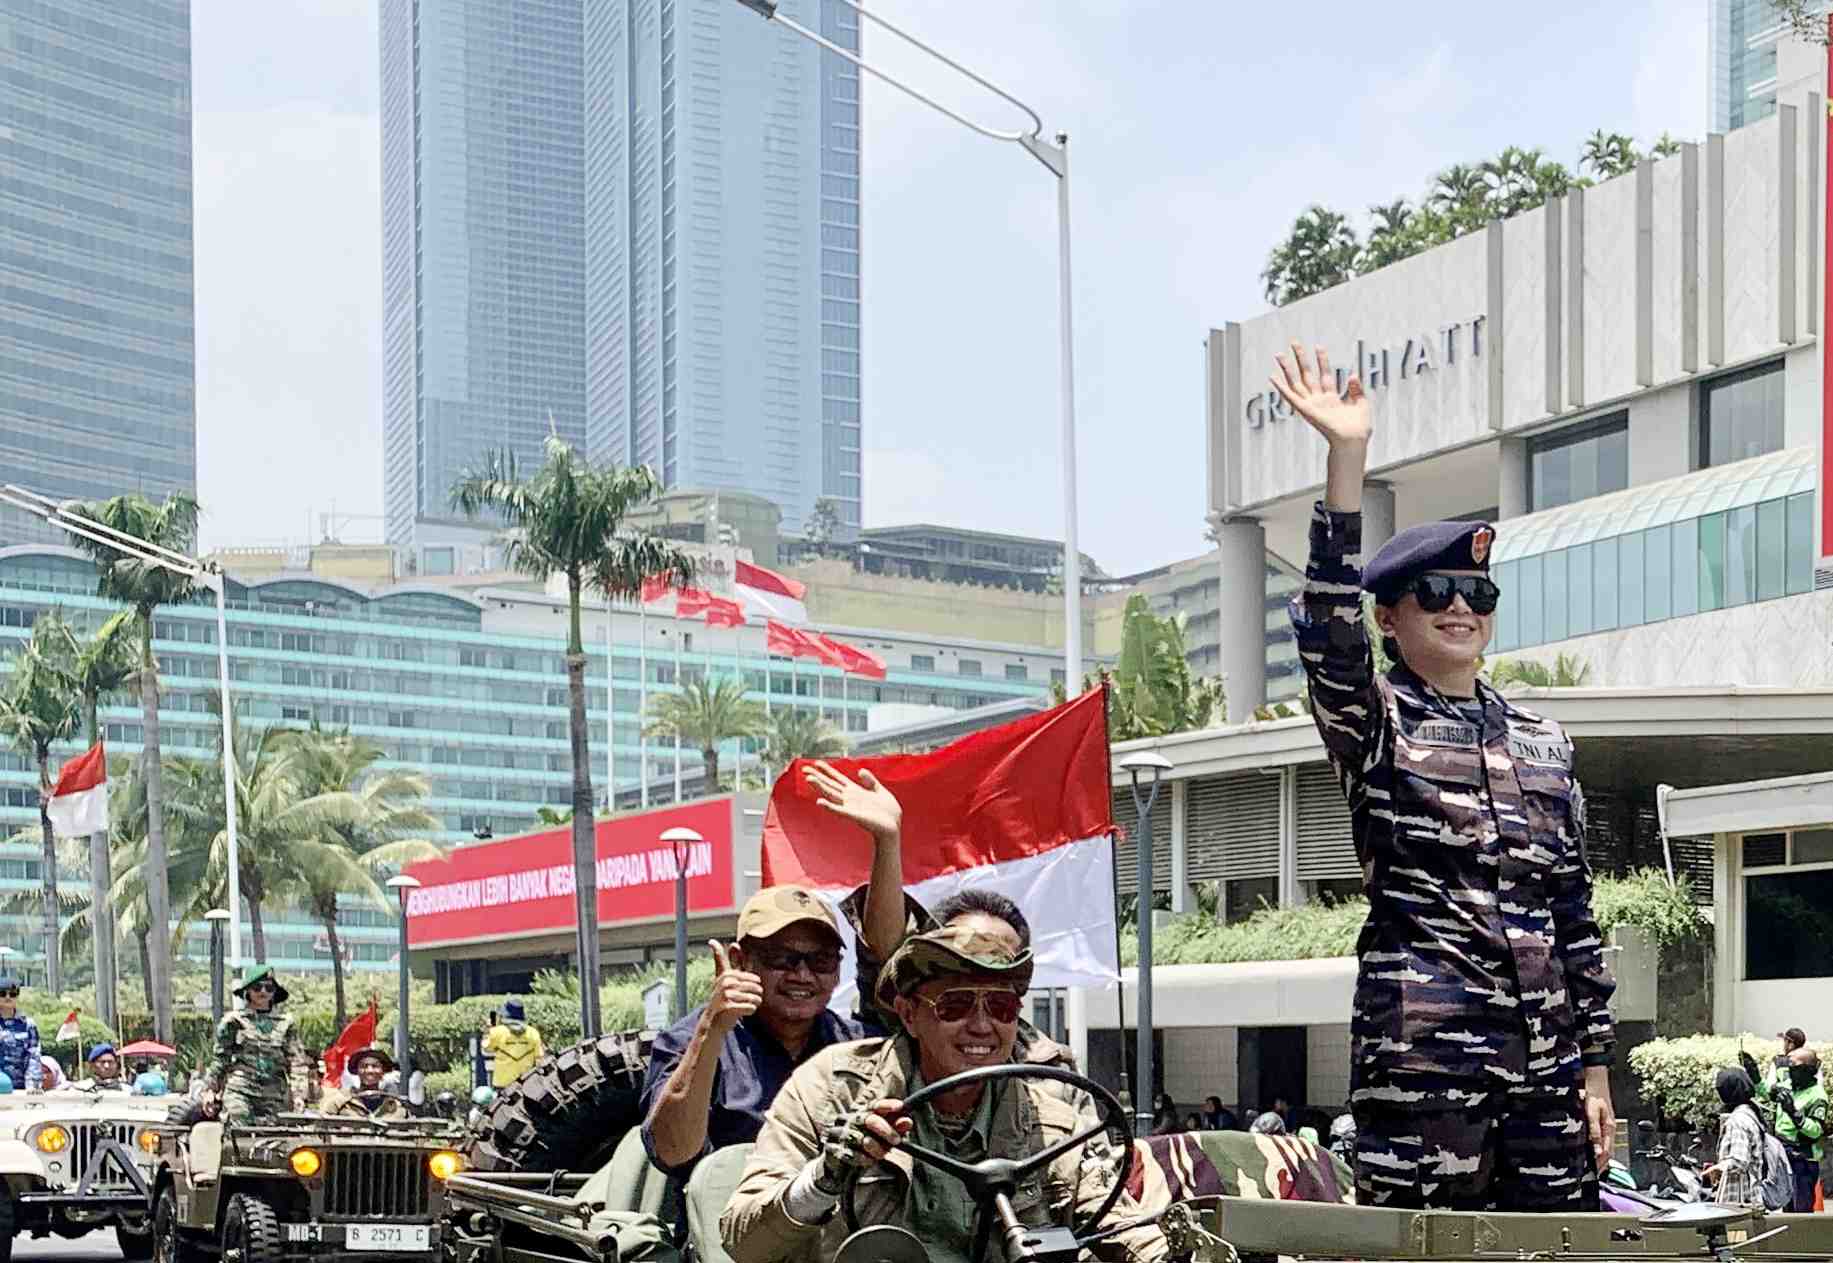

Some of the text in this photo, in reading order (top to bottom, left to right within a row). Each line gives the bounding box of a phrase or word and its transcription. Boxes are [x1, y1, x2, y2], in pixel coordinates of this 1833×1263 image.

[1369, 315, 1487, 390] HYATT
[1513, 740, 1568, 763] TNI AL
[548, 864, 576, 896] NEGA
[370, 1228, 402, 1241] 2571
